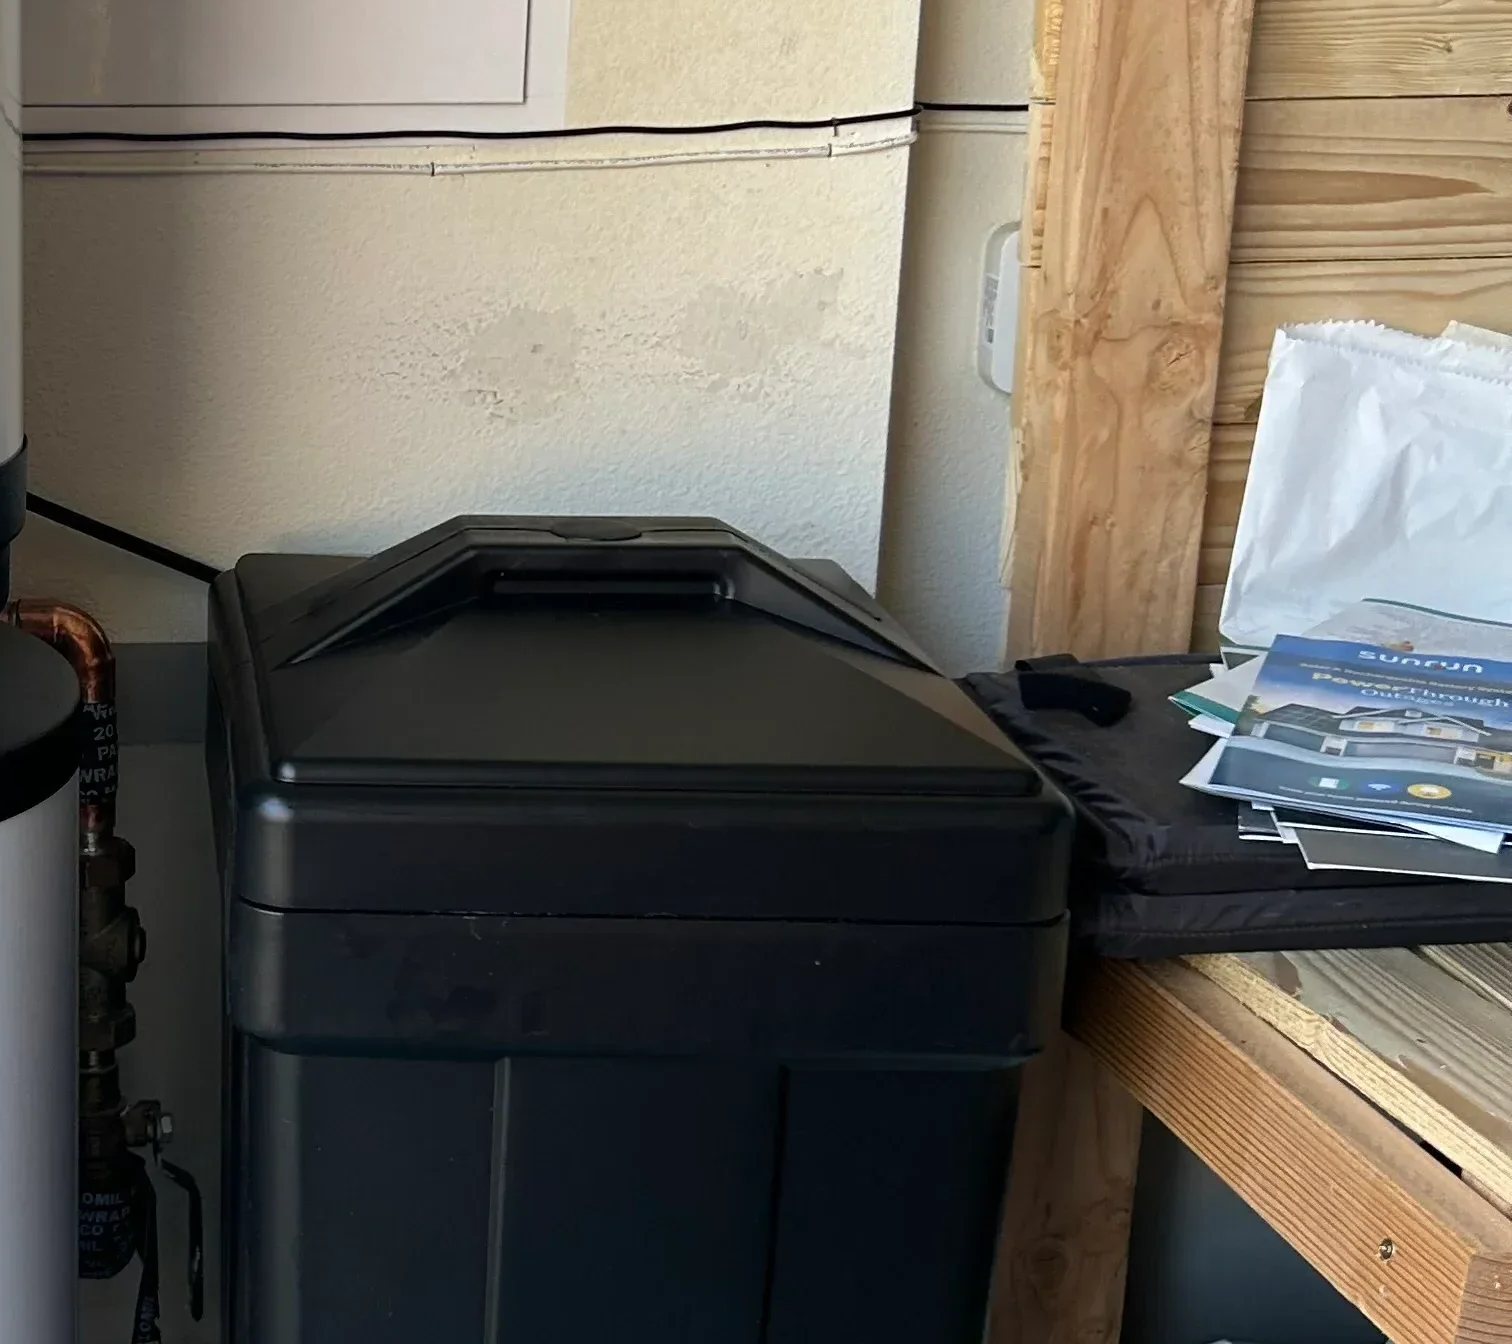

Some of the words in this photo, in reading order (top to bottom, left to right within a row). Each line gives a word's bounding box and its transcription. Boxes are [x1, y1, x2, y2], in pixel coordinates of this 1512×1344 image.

[1357, 649, 1484, 674] sunrun
[1312, 672, 1410, 692] Power
[1408, 687, 1509, 708] Through
[1360, 689, 1455, 706] Outages
[92, 723, 115, 741] 20
